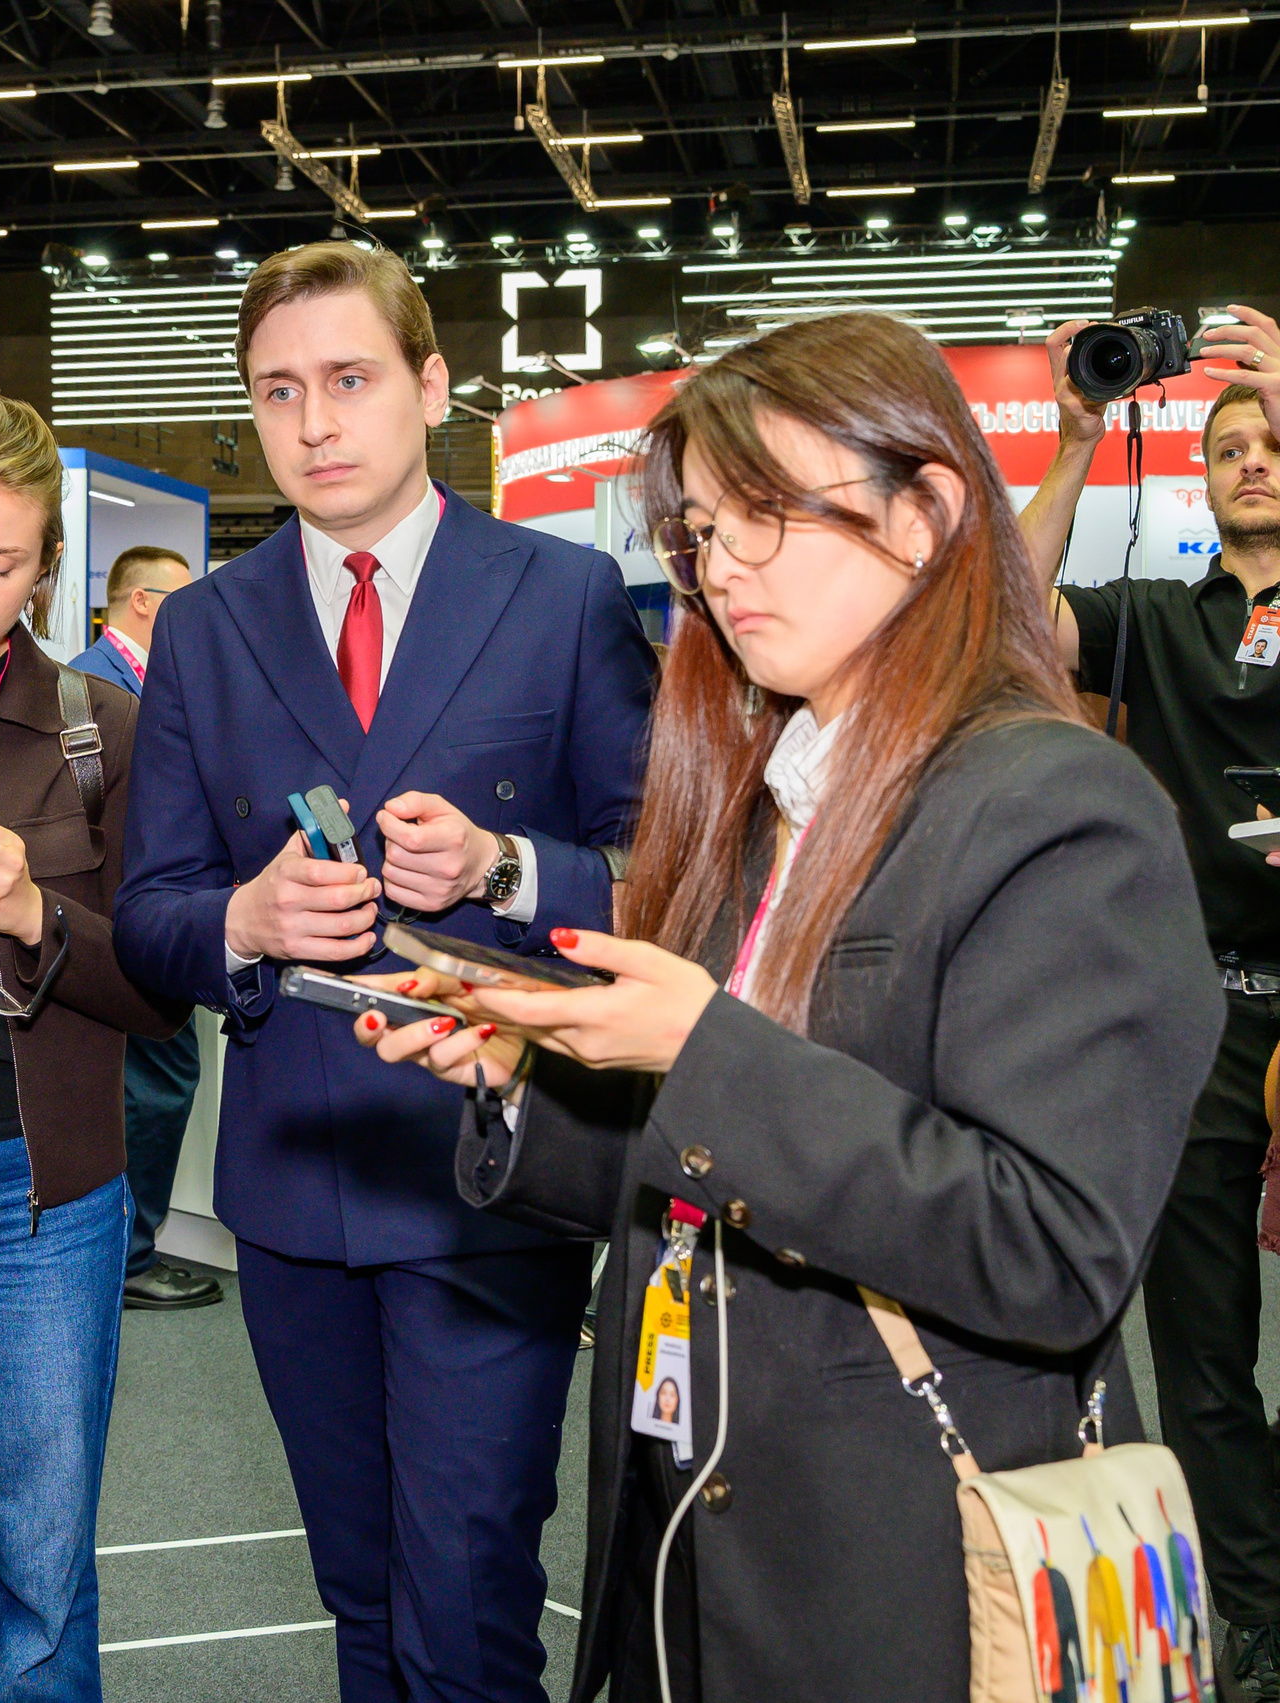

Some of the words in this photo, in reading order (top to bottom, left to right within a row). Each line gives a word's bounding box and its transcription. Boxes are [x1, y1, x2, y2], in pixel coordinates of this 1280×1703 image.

[1118, 315, 1145, 326] FUJIFILM
[1246, 622, 1257, 640] STAFF
[644, 1333, 654, 1375] PRESS
